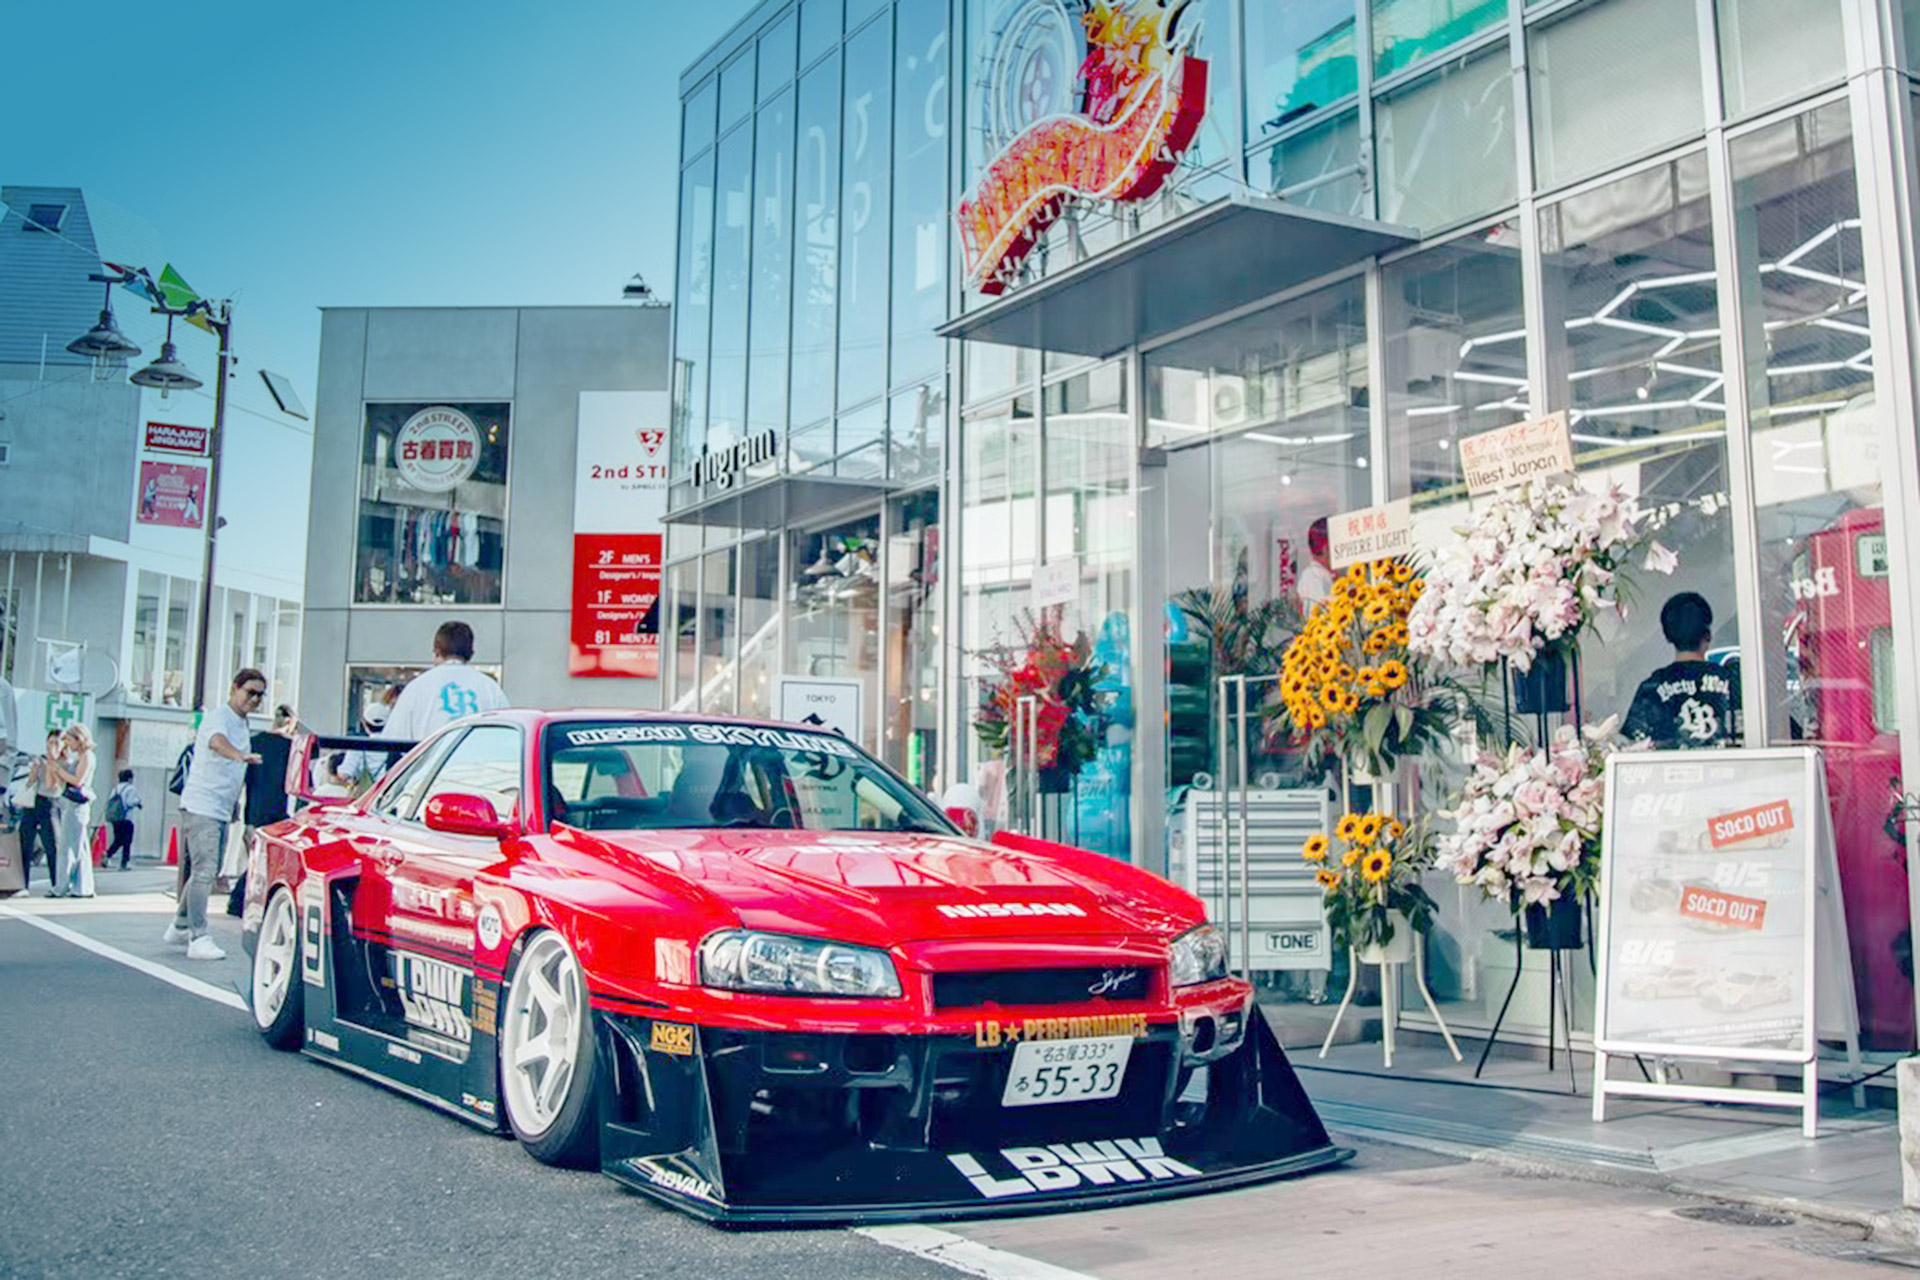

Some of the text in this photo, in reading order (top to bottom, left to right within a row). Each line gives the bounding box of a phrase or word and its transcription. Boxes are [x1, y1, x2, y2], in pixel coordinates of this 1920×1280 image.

[149, 425, 205, 440] HARAJUKU
[402, 440, 474, 460] 古着買取
[590, 464, 628, 479] 2nd
[1467, 467, 1505, 488] illest
[1334, 529, 1408, 559] SPHERE LIGHT
[598, 550, 651, 565] 2F MEN'S
[597, 589, 612, 604] 1F
[595, 630, 610, 644] B1
[806, 695, 836, 704] TOKYO
[567, 724, 858, 758] NISSAN SKYLINE
[1714, 806, 1786, 840] SOLD OUT
[936, 903, 1087, 918] NISSAN
[1687, 893, 1759, 923] SOLD OUT
[1271, 934, 1314, 949] TONE
[653, 1023, 690, 1048] NGK
[976, 1013, 1148, 1048] LB PERFORMANCE
[1015, 1063, 1118, 1098] る 55-33
[948, 1137, 1203, 1198] LBWK
[650, 1168, 712, 1196] ADVAN
